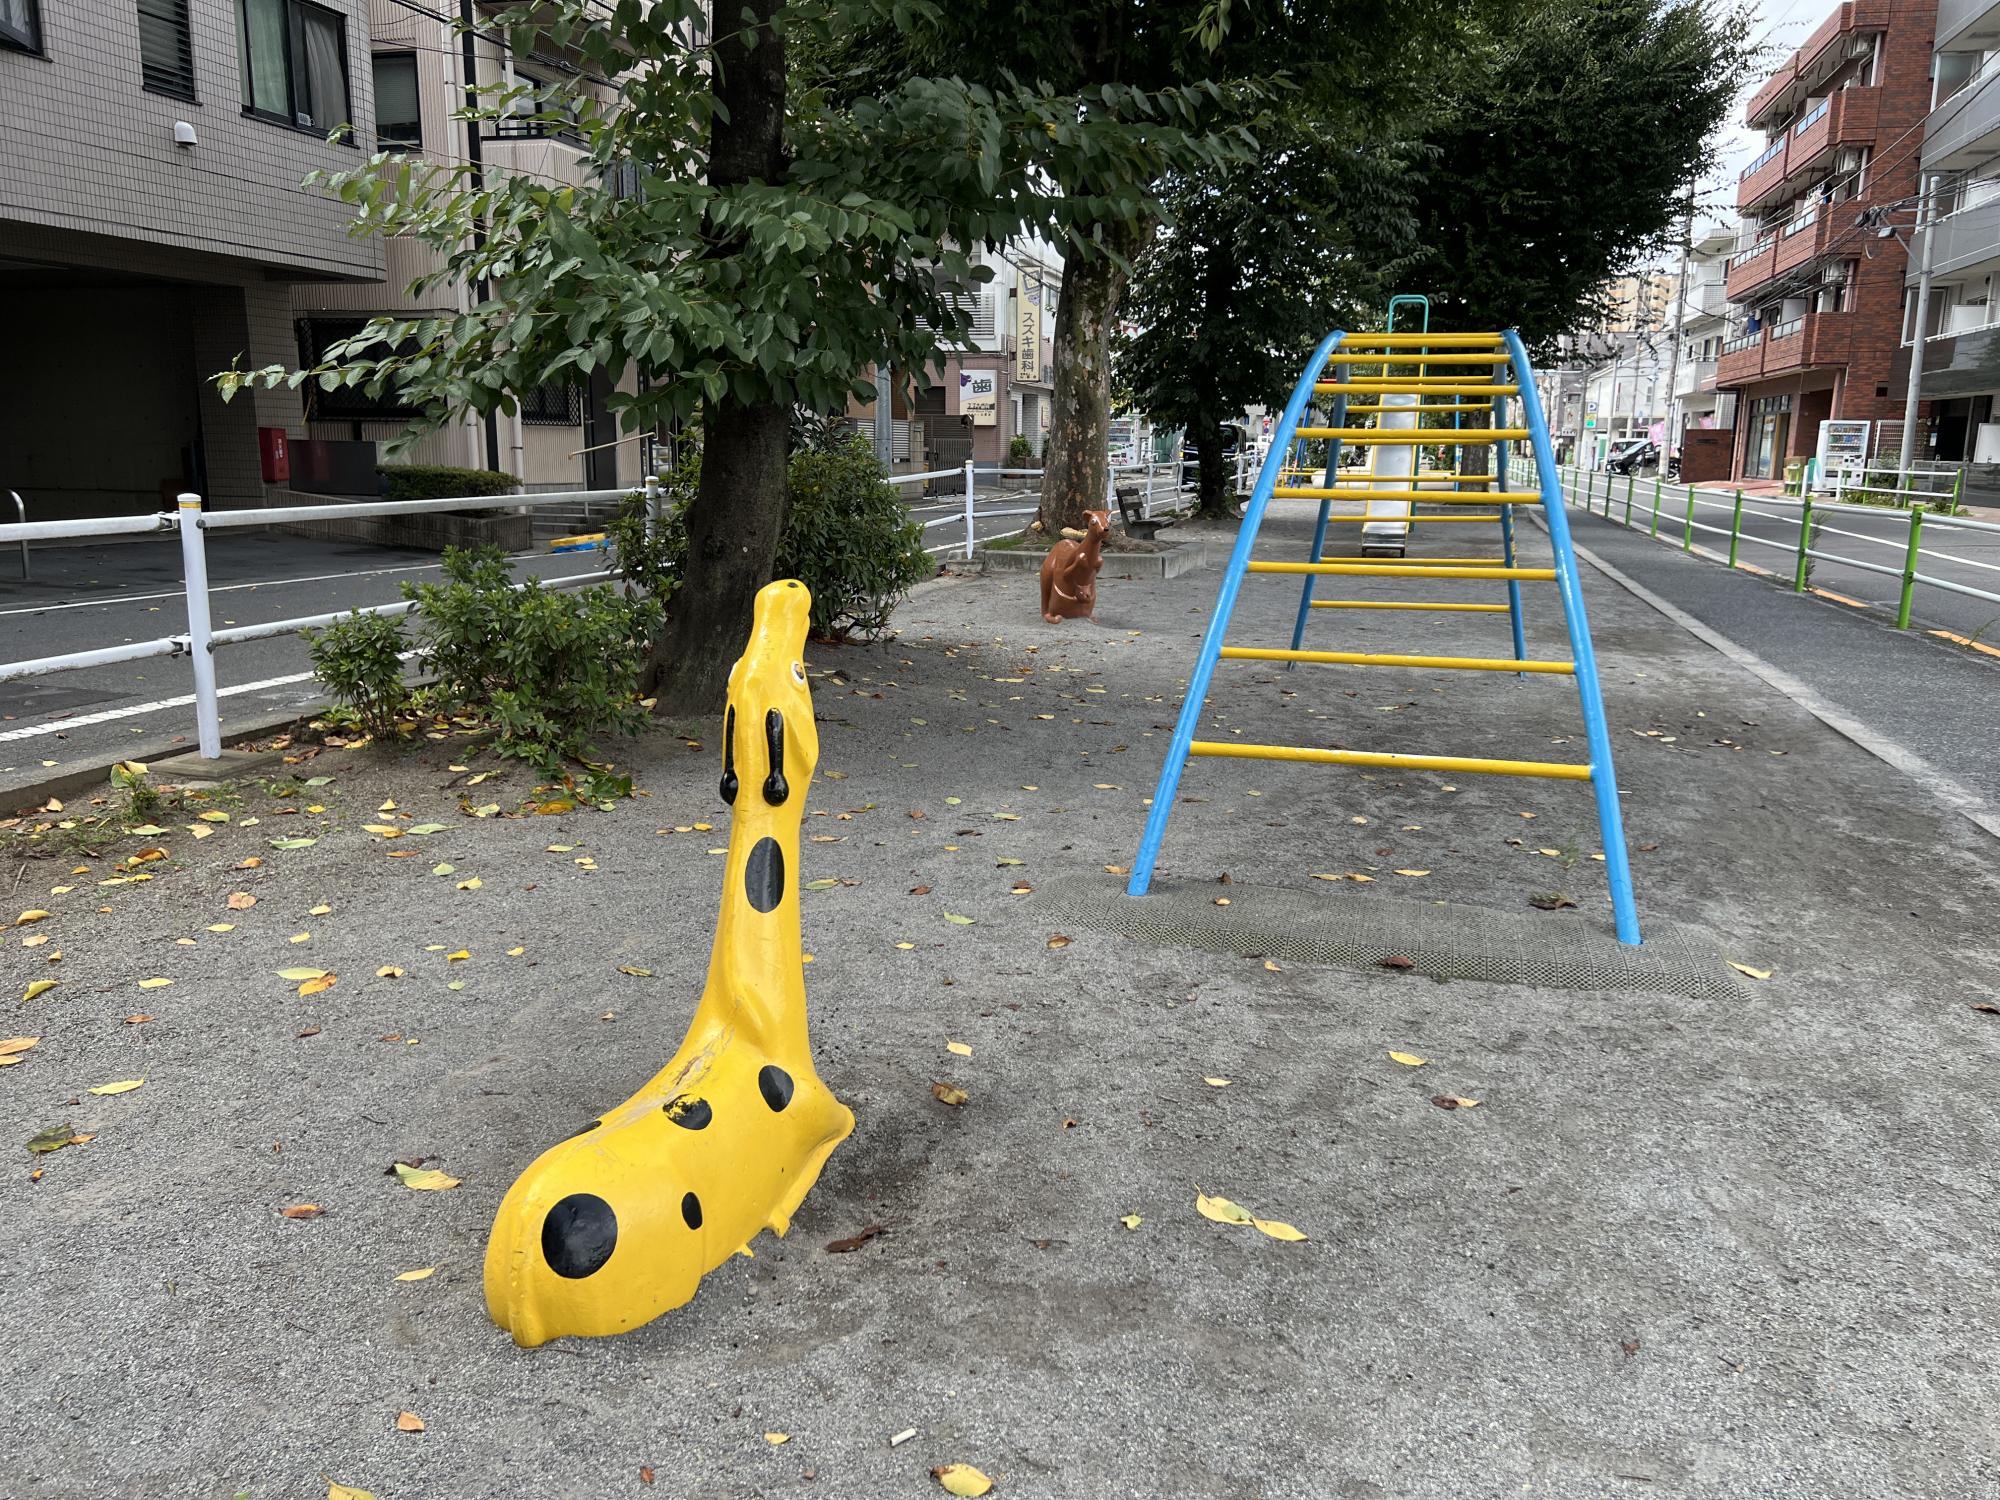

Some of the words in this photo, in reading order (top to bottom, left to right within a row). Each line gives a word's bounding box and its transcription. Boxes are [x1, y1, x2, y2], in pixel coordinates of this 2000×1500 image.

[1021, 312, 1035, 372] スズキ歯科
[971, 379, 993, 393] 歯
